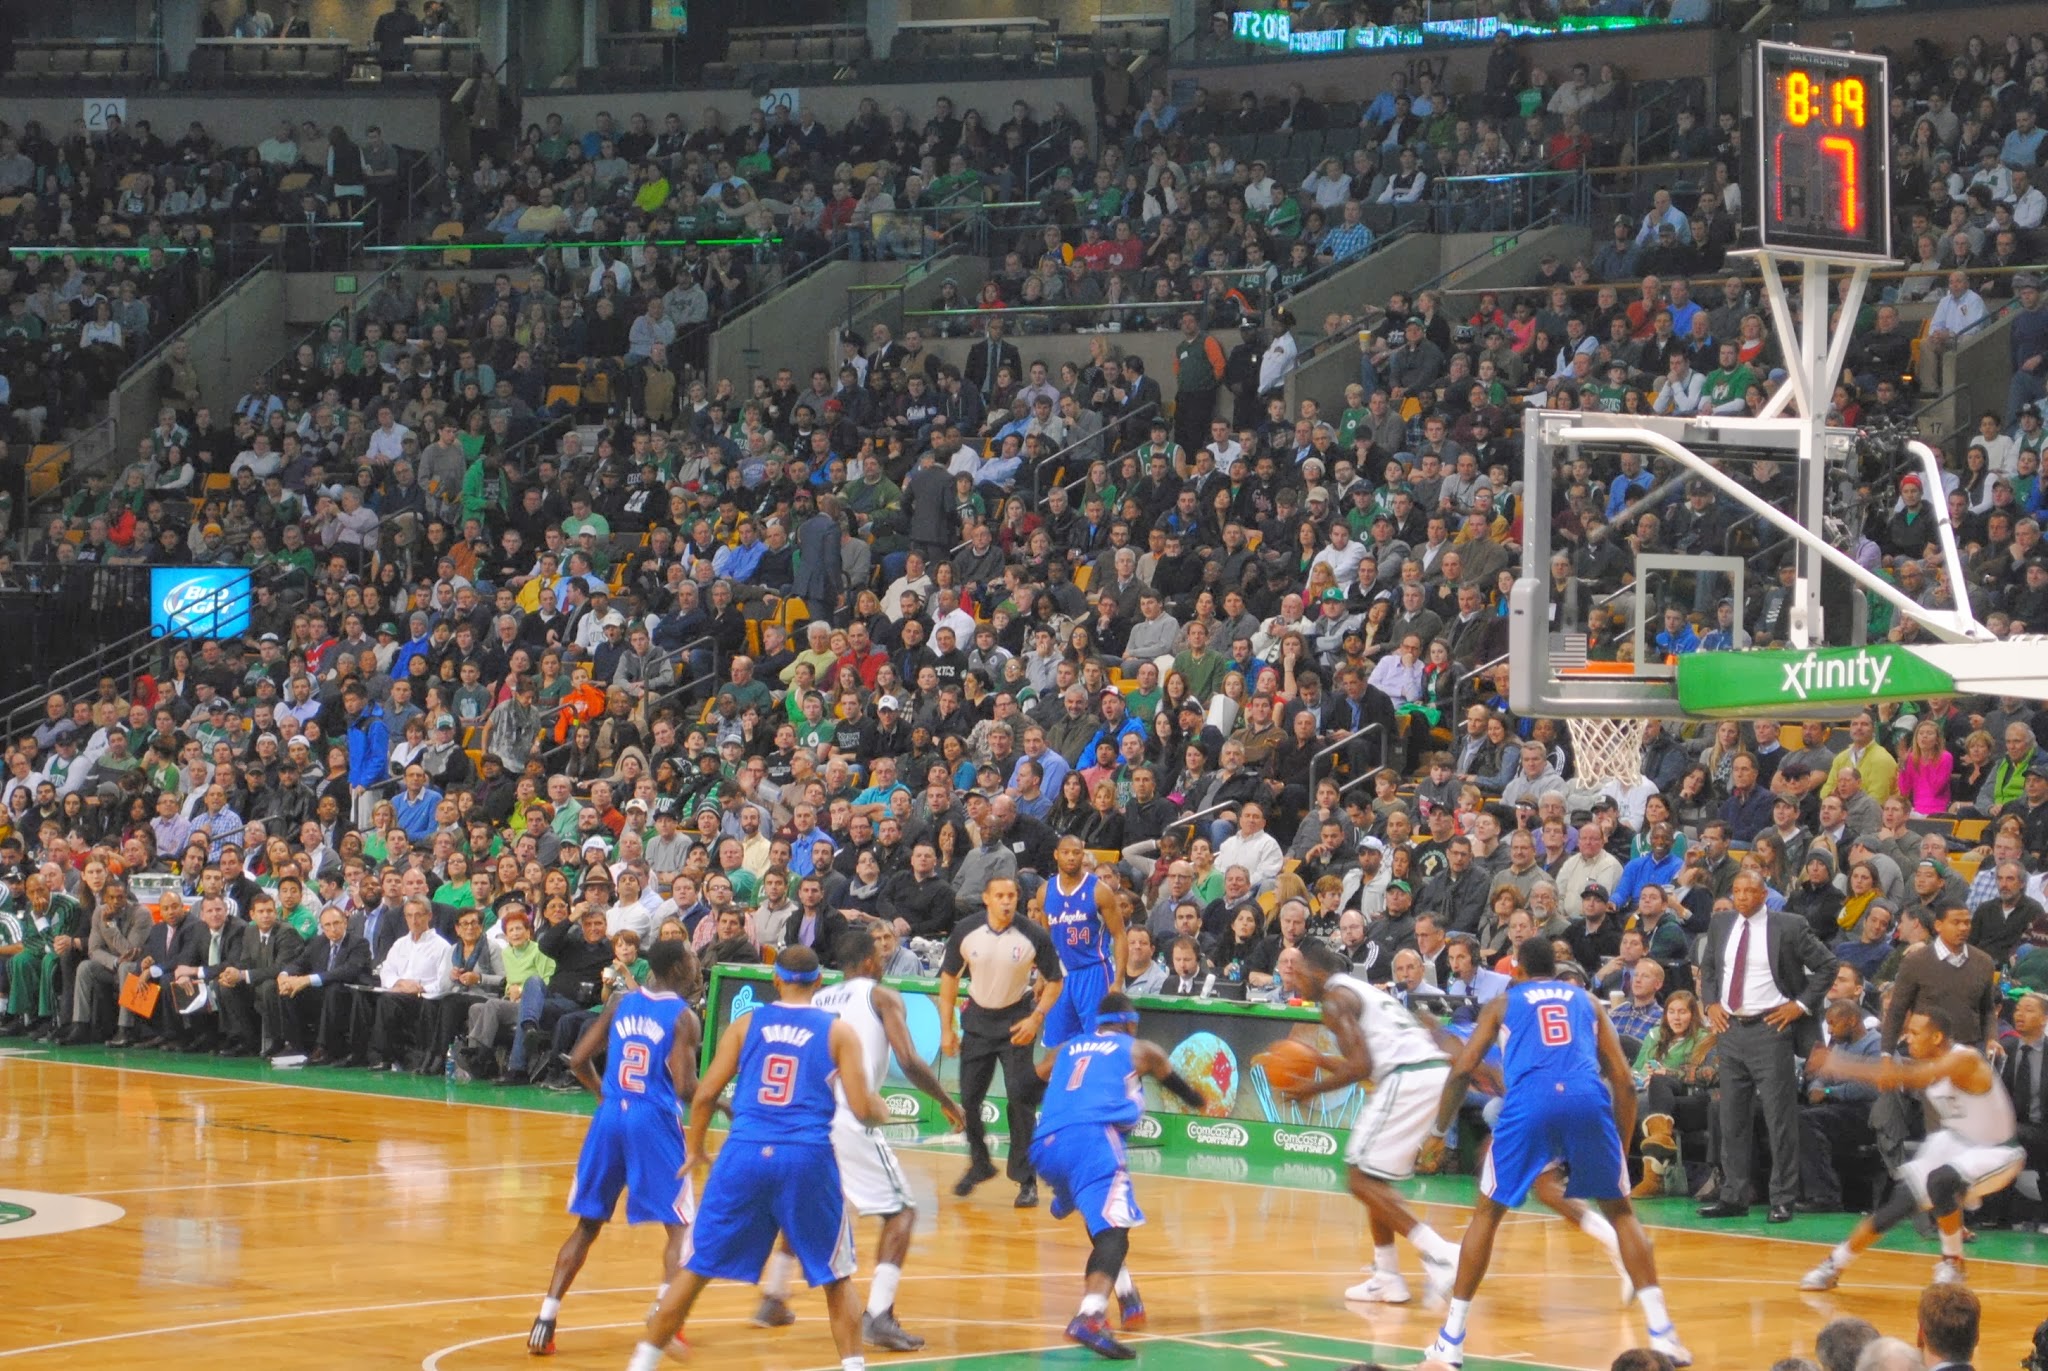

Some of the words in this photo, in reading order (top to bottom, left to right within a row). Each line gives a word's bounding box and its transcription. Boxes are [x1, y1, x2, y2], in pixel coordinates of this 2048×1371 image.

[1786, 71, 1865, 129] 8:19
[1821, 136, 1857, 233] 7
[1781, 649, 1893, 699] xfinity
[1067, 926, 1090, 945] 34
[1537, 1004, 1572, 1047] 6
[618, 1041, 650, 1094] 2
[757, 1053, 799, 1107] 9
[1065, 1055, 1092, 1091] 1
